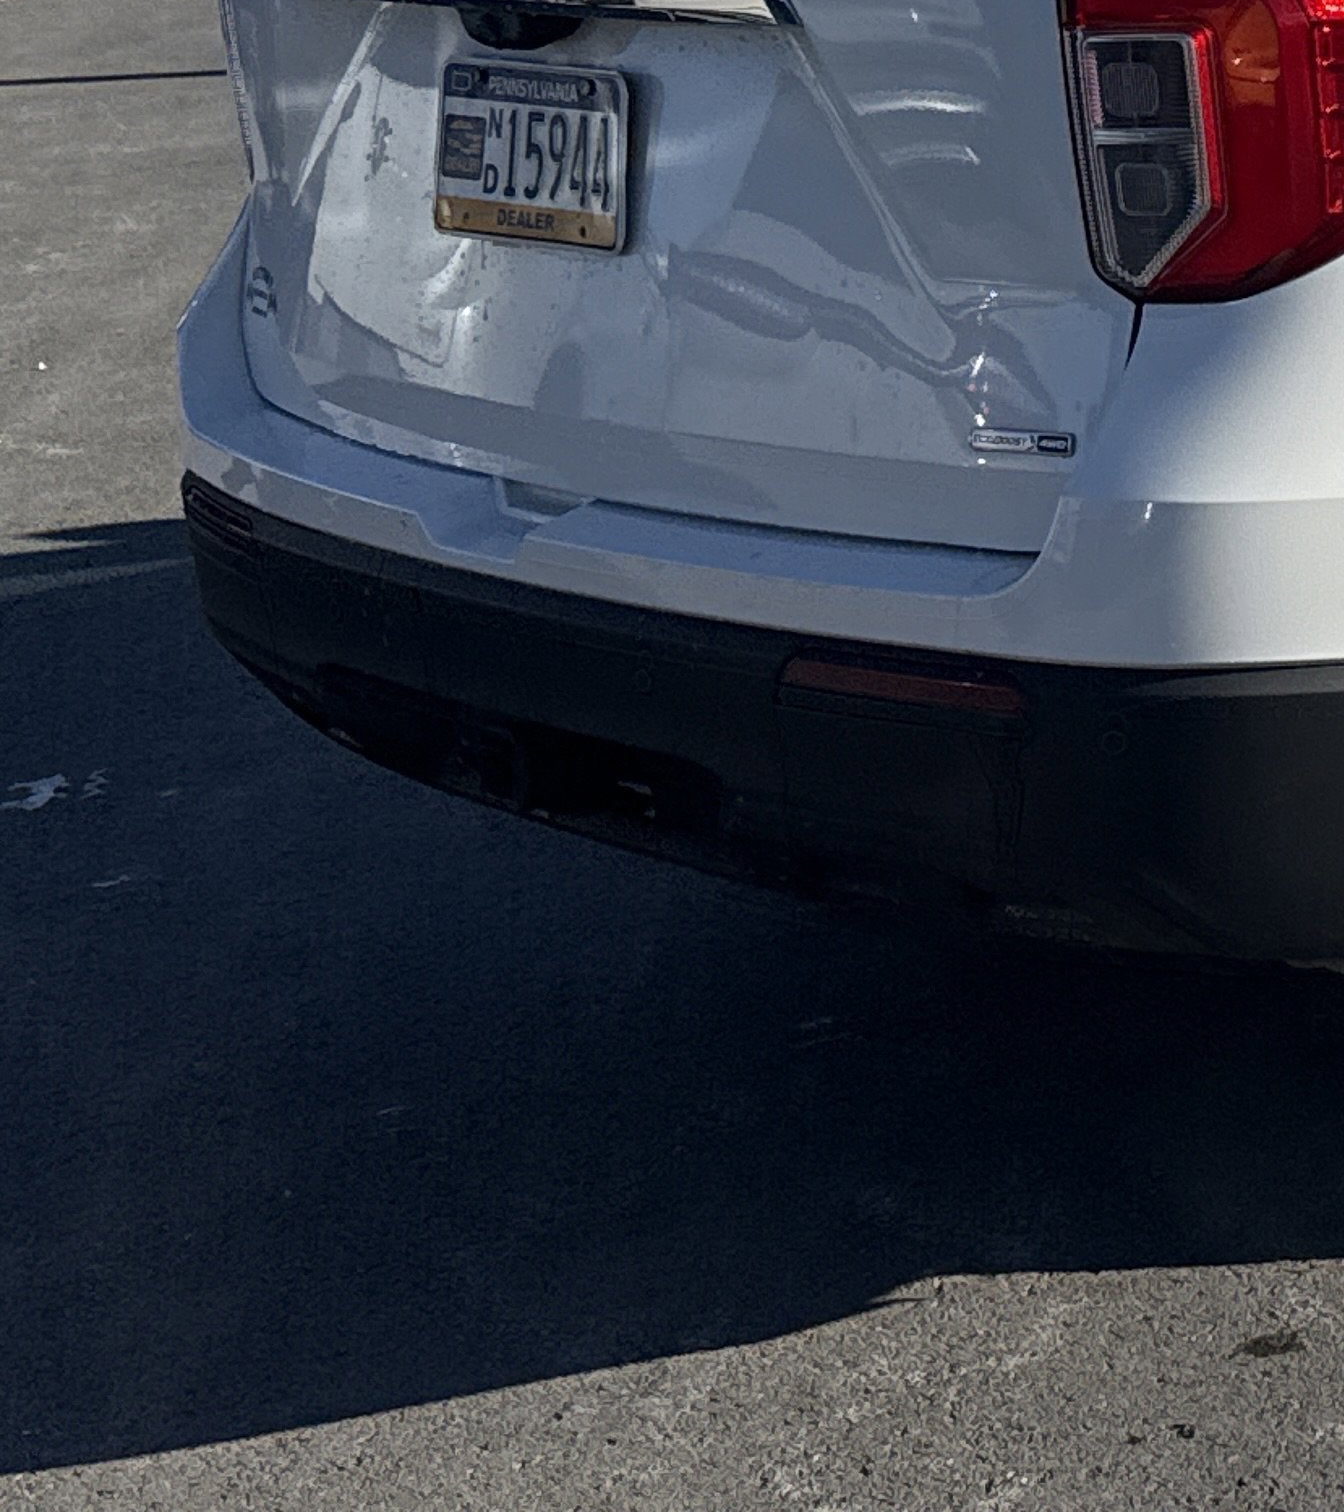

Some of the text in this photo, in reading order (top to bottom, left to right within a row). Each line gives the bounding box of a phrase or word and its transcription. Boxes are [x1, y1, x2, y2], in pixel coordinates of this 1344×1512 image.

[488, 75, 579, 103] PENNSYLVANIA
[487, 106, 504, 139] N
[503, 109, 611, 212] 15944
[482, 163, 499, 194] D
[497, 208, 555, 232] DEALER
